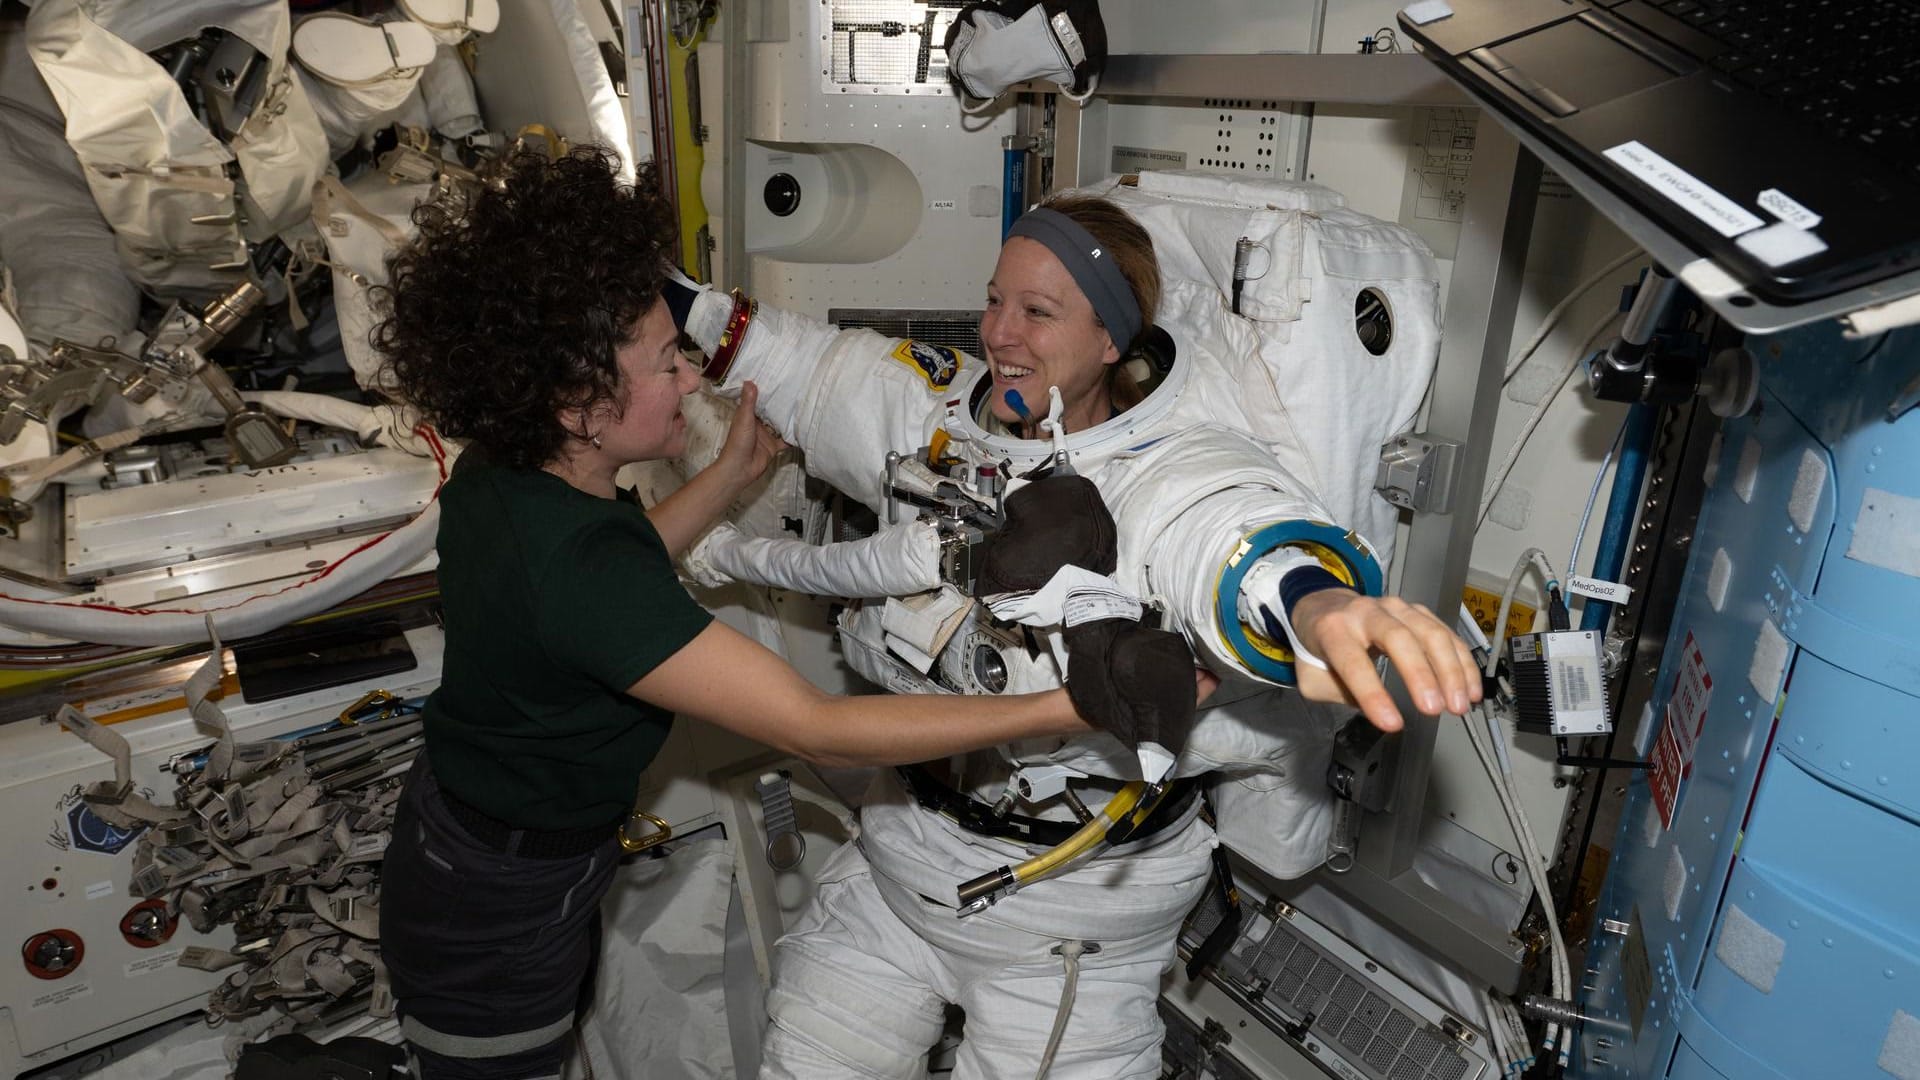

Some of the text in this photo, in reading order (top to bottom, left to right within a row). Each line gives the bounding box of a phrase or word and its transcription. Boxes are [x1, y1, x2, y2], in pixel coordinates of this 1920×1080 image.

[1150, 153, 1182, 162] RECEPTACLE
[1572, 580, 1615, 596] MedOps02
[1681, 685, 1695, 721] FIRE
[1659, 781, 1675, 817] PFE
